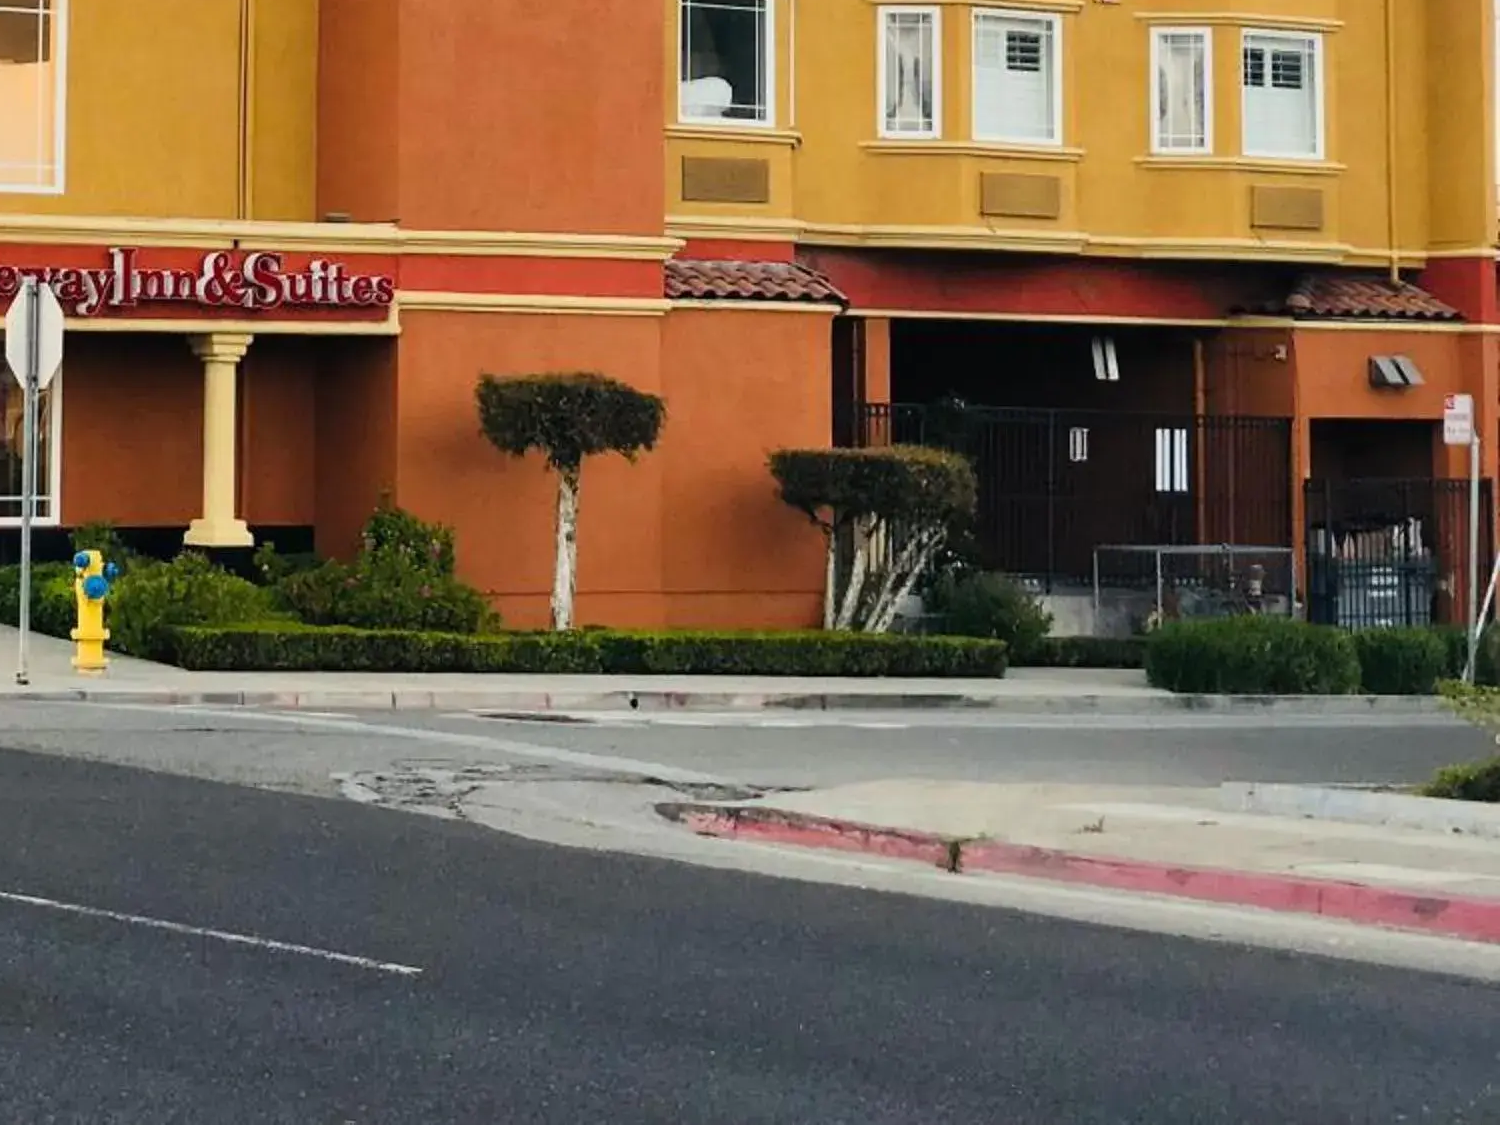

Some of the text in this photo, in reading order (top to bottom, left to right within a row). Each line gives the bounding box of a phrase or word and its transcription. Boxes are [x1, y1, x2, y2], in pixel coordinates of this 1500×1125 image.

[108, 247, 198, 307] Inn
[201, 251, 246, 305] &
[244, 252, 395, 310] Suites
